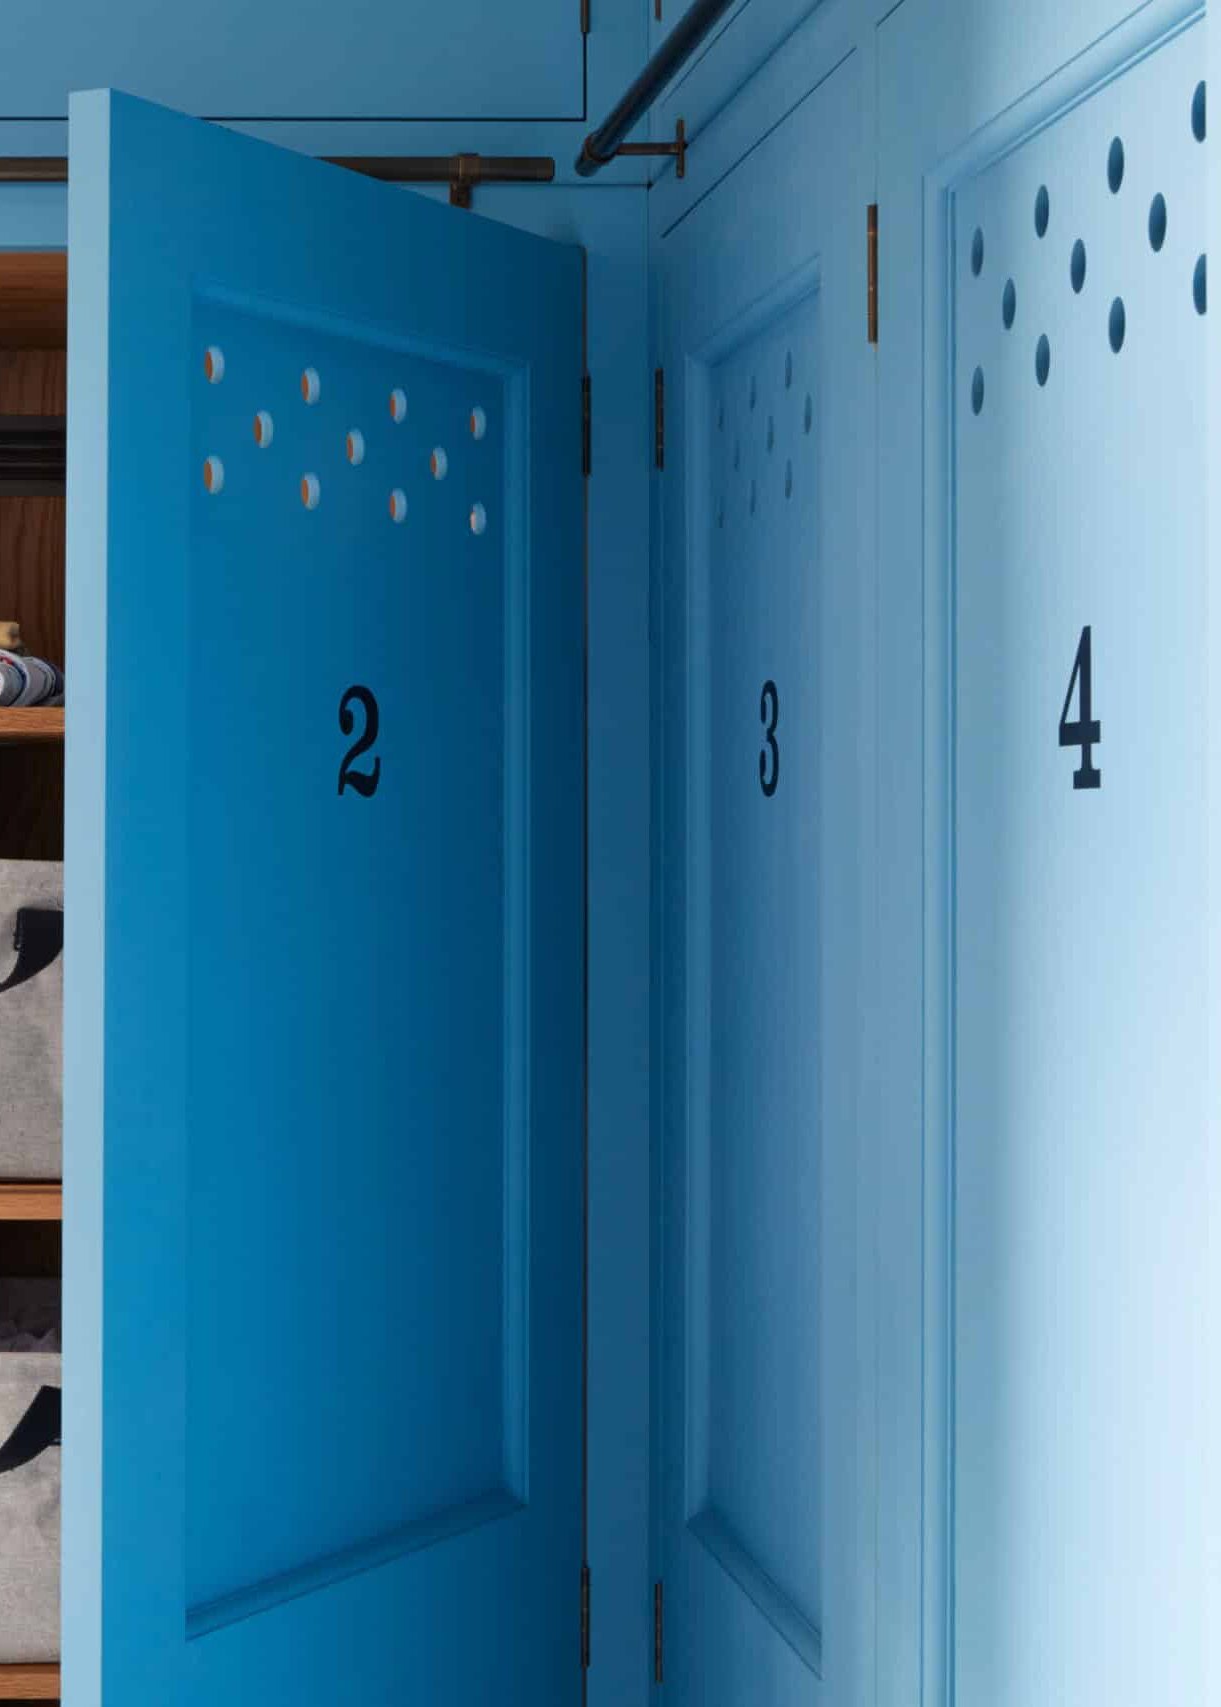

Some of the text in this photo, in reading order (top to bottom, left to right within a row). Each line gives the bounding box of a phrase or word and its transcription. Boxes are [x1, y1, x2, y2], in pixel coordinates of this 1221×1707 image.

[337, 685, 381, 798] 2
[759, 679, 780, 798] 3
[1059, 626, 1101, 790] 4
